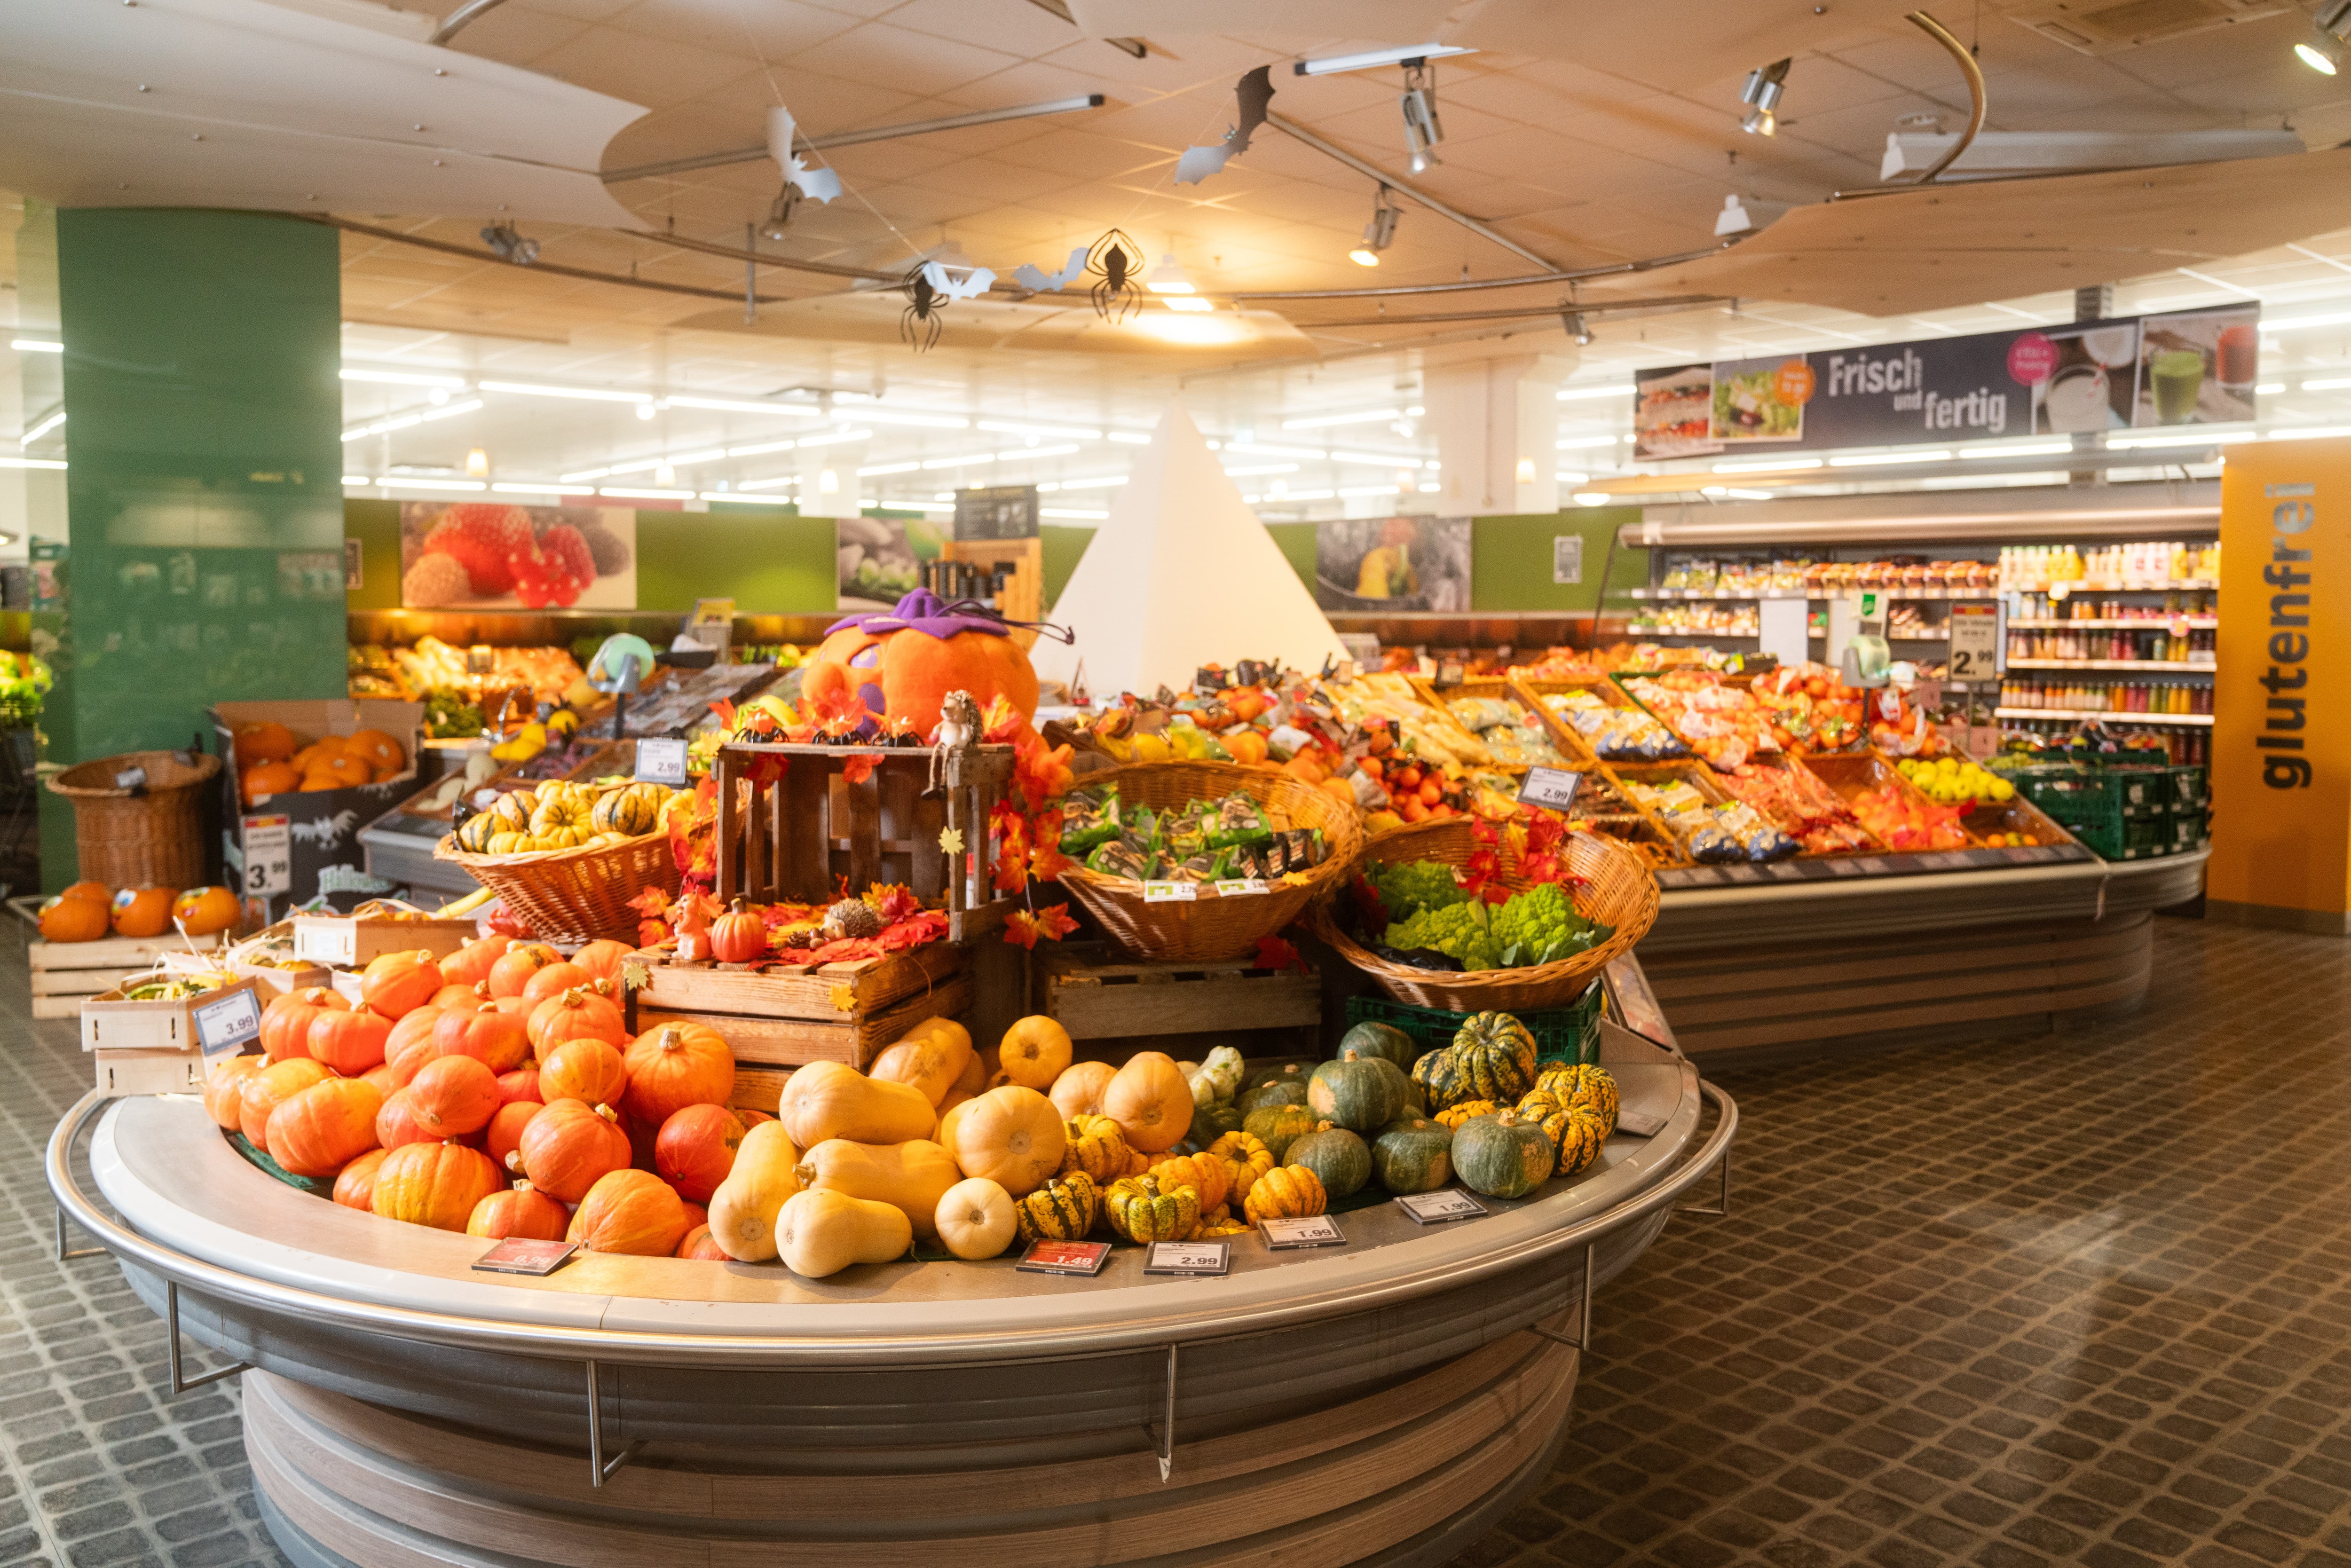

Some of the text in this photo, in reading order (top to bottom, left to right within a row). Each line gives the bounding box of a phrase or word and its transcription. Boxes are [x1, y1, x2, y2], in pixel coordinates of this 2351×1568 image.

[1828, 347, 1923, 397] Frisch
[1925, 386, 2007, 433] fertig
[2256, 482, 2316, 789] glutenfrei
[657, 761, 680, 772] 2.99
[1543, 787, 1568, 800] 2.99
[226, 1015, 253, 1034] 3.99
[1439, 1201, 1471, 1212] 1.99
[1297, 1228, 1332, 1237] 1.99
[513, 1254, 552, 1265] 0.99
[1057, 1255, 1093, 1265] 1.49
[1181, 1256, 1218, 1265] 2.99
